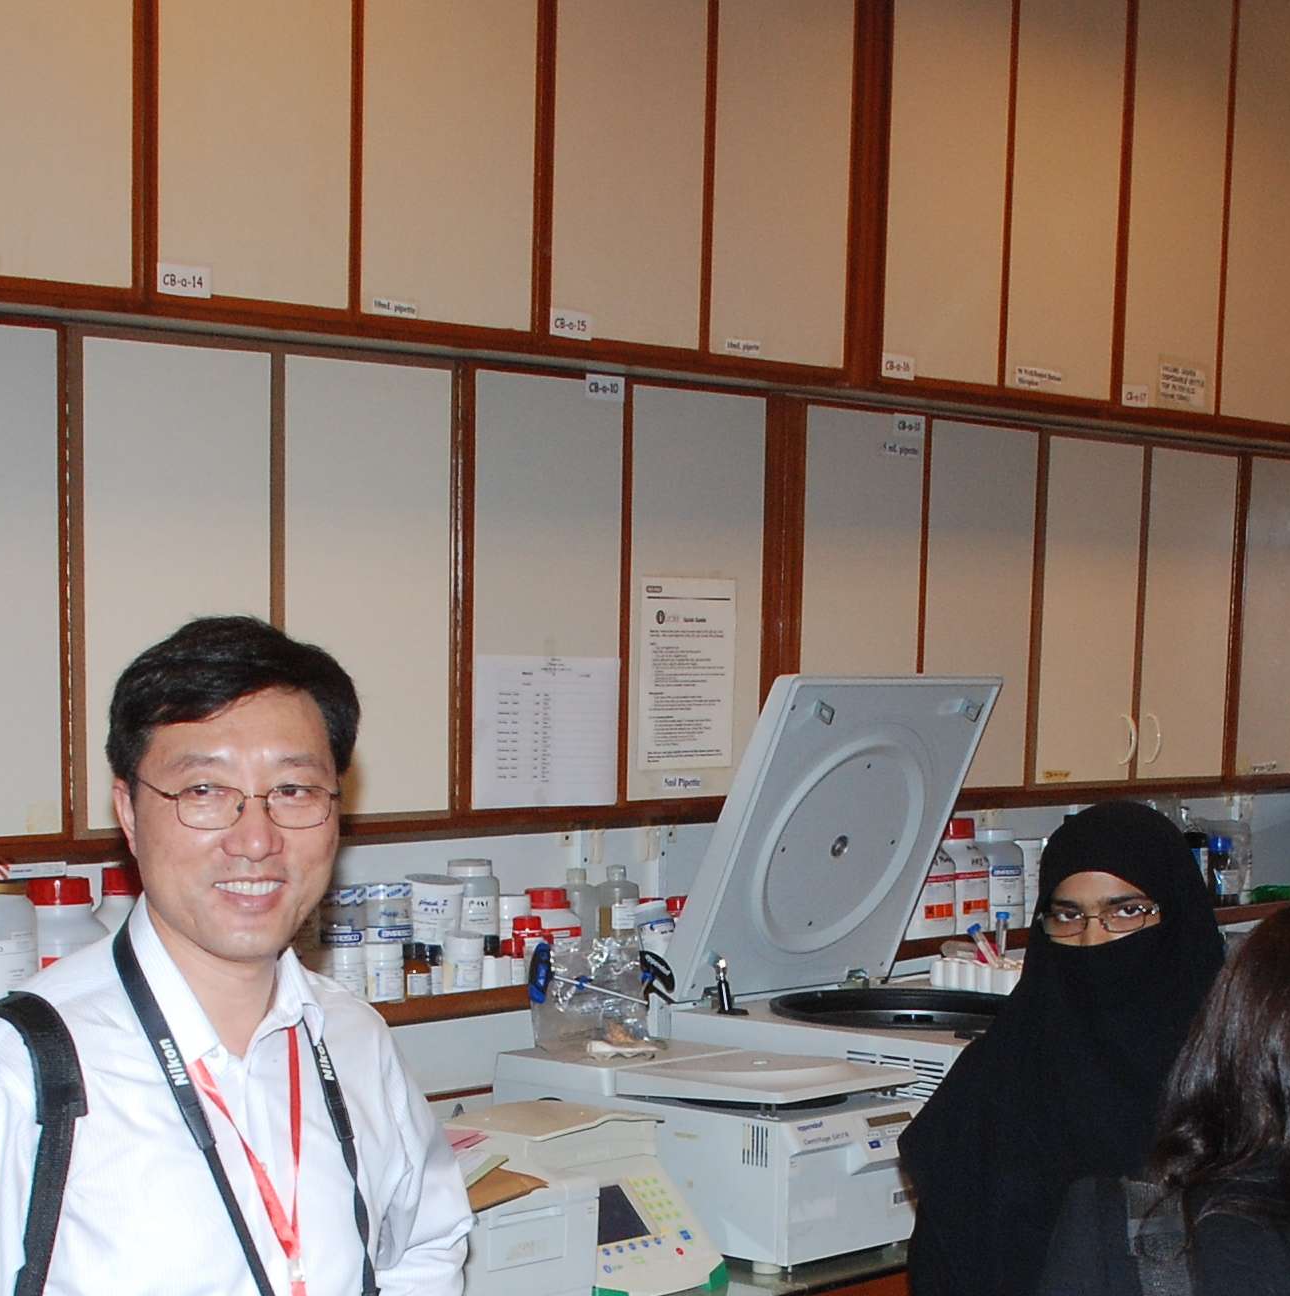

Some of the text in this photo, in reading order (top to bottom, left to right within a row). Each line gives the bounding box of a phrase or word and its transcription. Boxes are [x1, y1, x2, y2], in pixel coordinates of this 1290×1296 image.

[163, 274, 203, 288] CB-a-14
[554, 318, 586, 331] CB-a-15
[159, 1037, 189, 1087] Nikon
[315, 1041, 336, 1082] Niko
